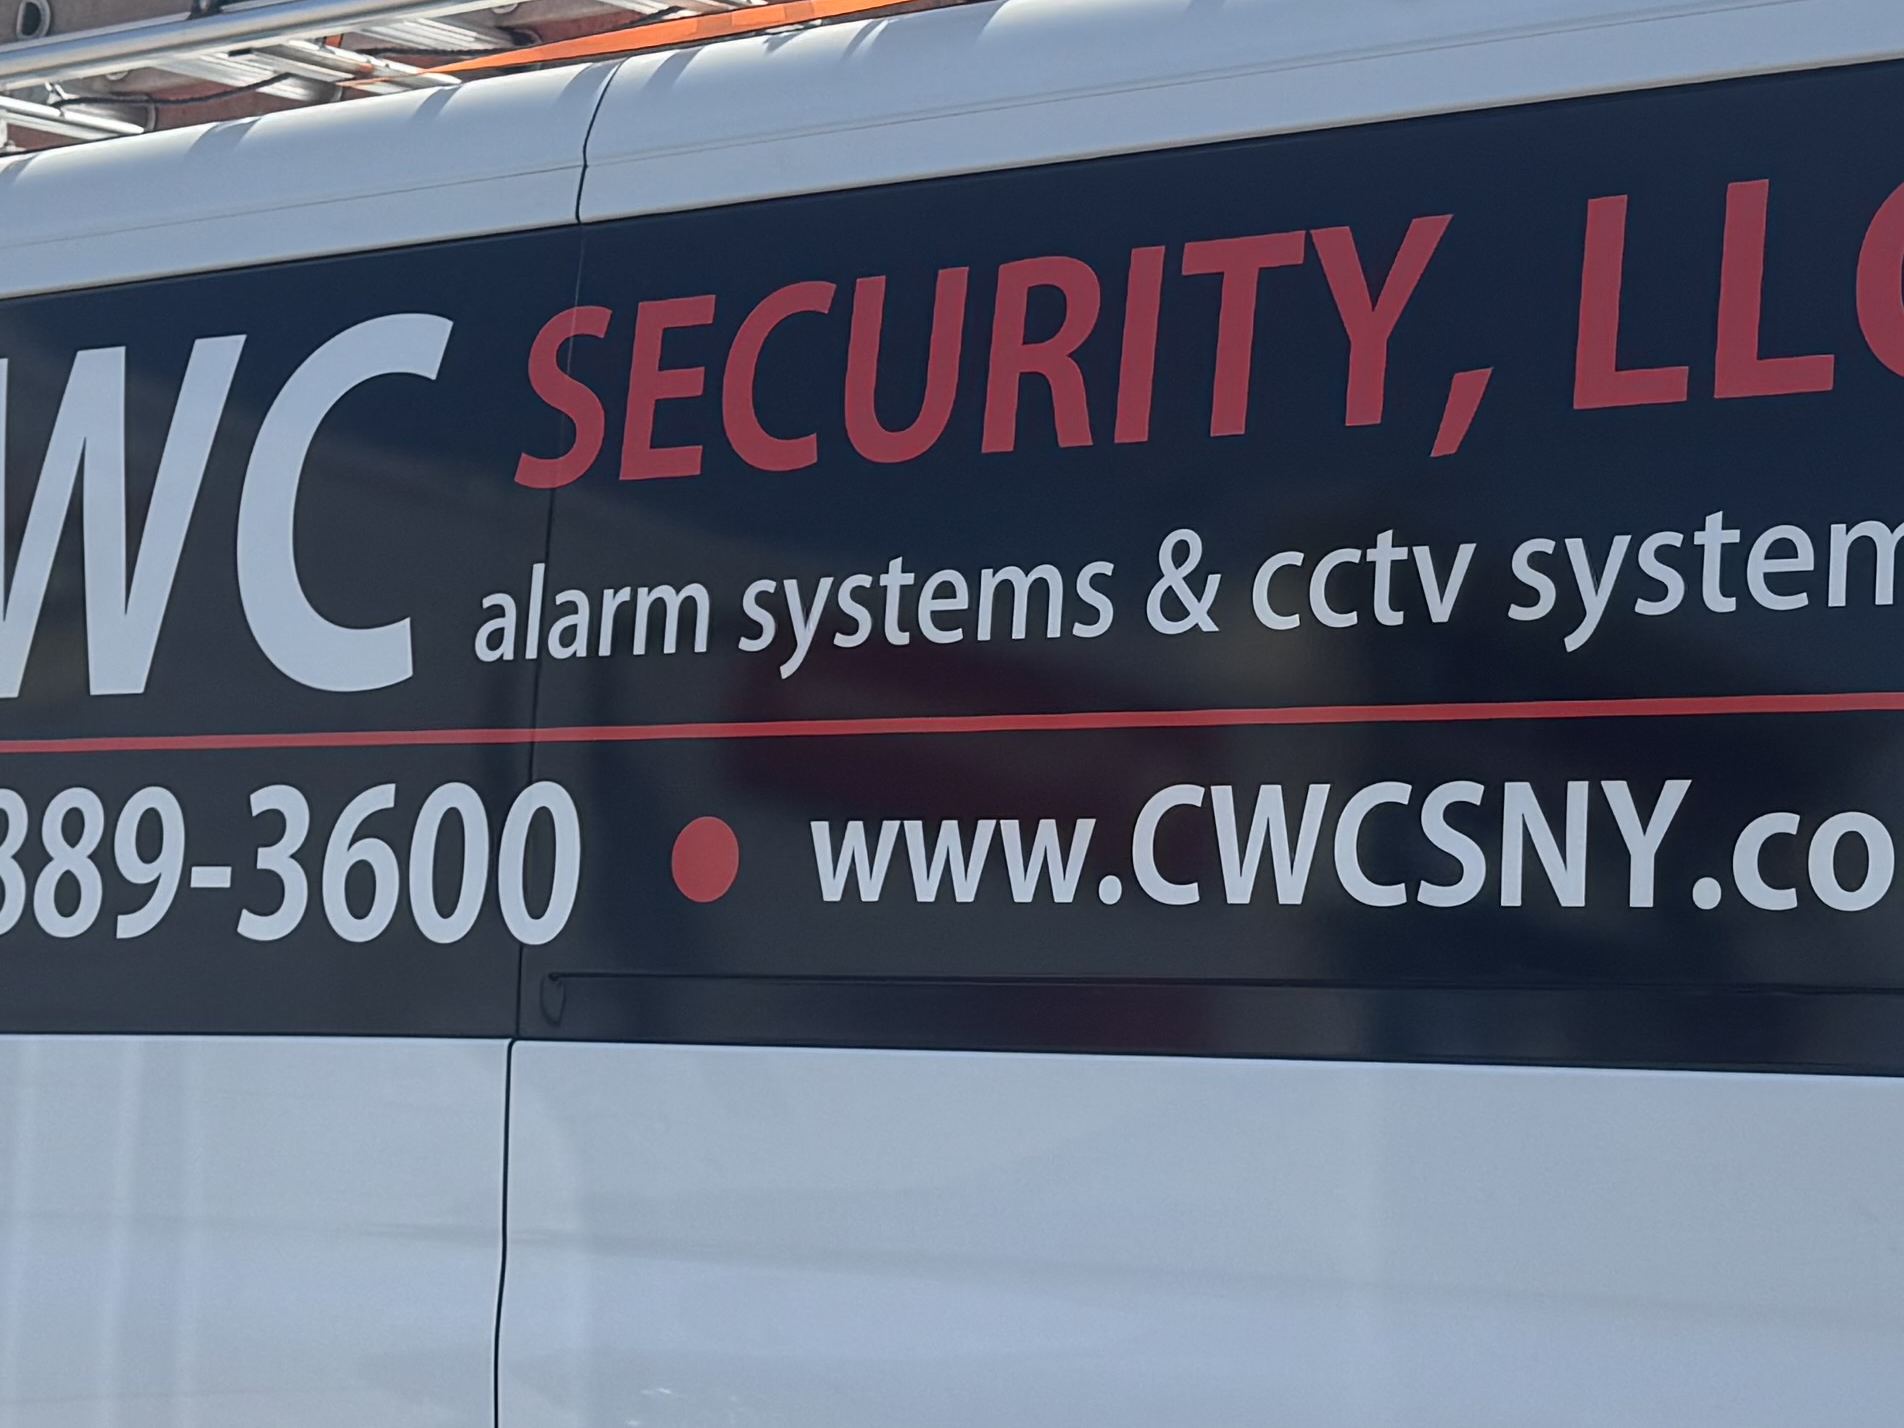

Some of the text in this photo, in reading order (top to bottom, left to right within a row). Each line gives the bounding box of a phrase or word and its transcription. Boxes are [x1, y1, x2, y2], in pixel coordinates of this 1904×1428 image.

[514, 213, 1493, 488] SECURITY,
[473, 563, 710, 662] alarm
[738, 556, 1115, 679] systems
[1145, 528, 1221, 634] &
[1251, 529, 1477, 629] cctv
